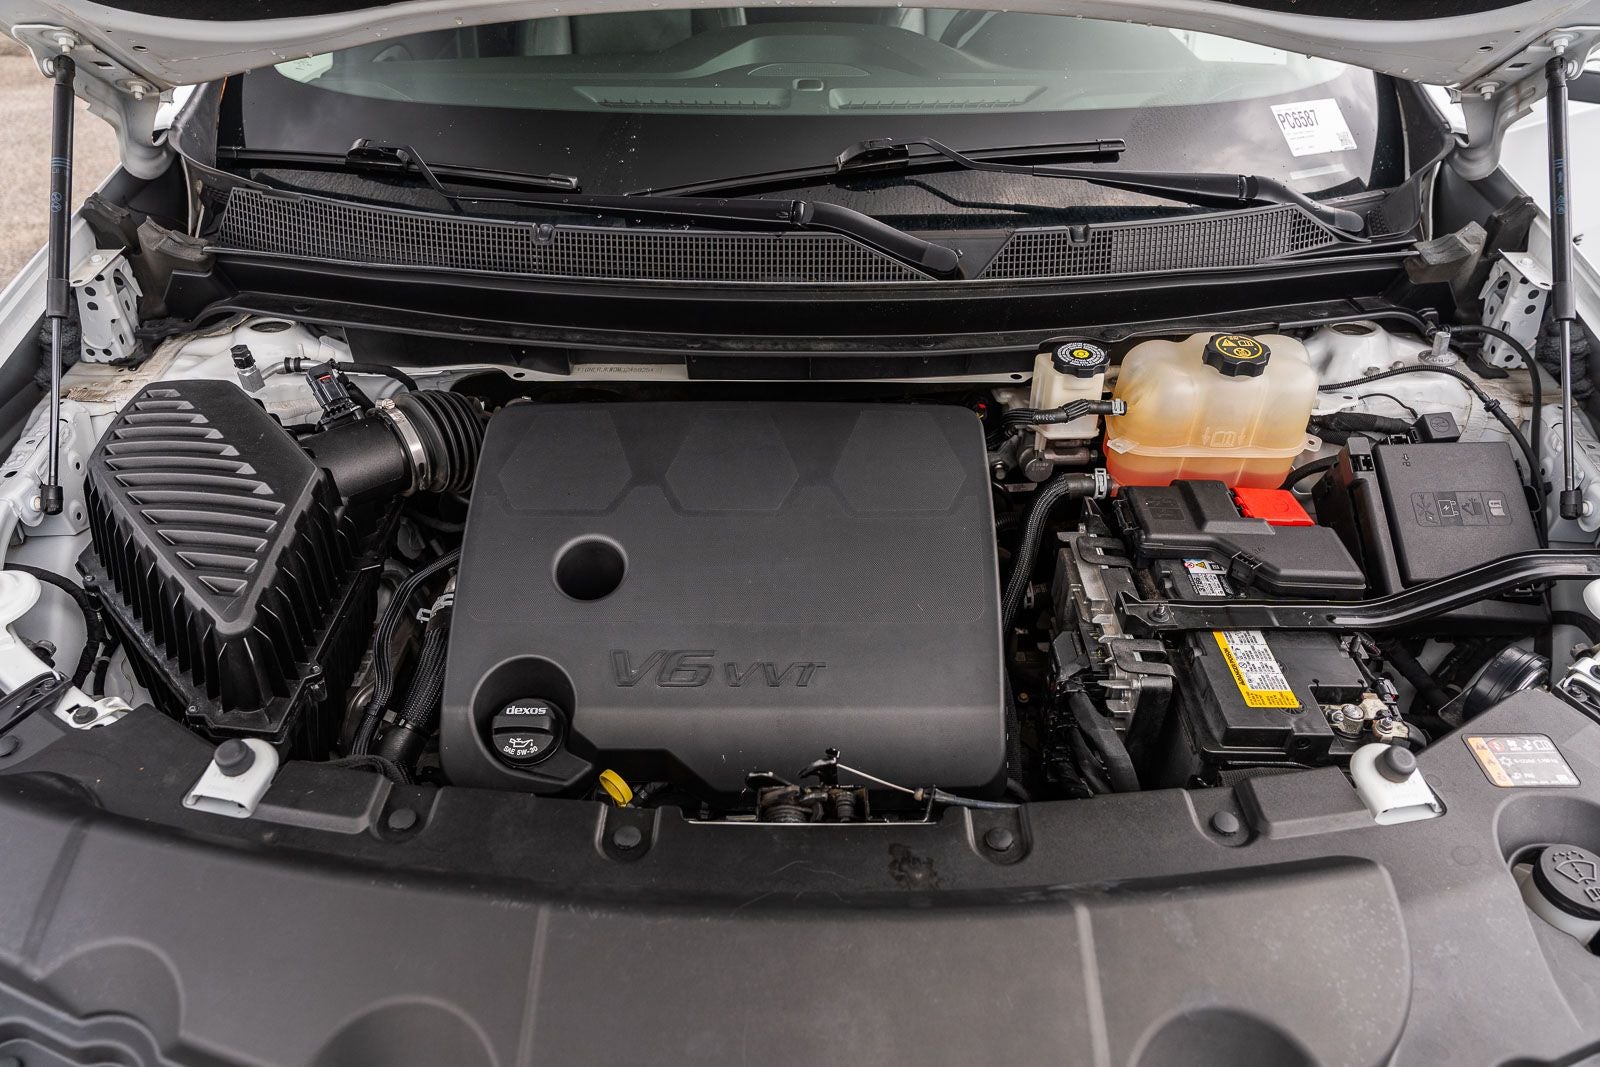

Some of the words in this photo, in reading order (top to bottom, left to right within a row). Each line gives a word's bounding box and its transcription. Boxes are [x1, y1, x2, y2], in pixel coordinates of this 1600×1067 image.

[1277, 110, 1319, 130] PC6587
[609, 649, 717, 688] V6
[724, 661, 827, 688] VVT
[506, 705, 548, 715] dexos
[503, 745, 516, 755] SAE
[516, 745, 539, 756] 5W-30
